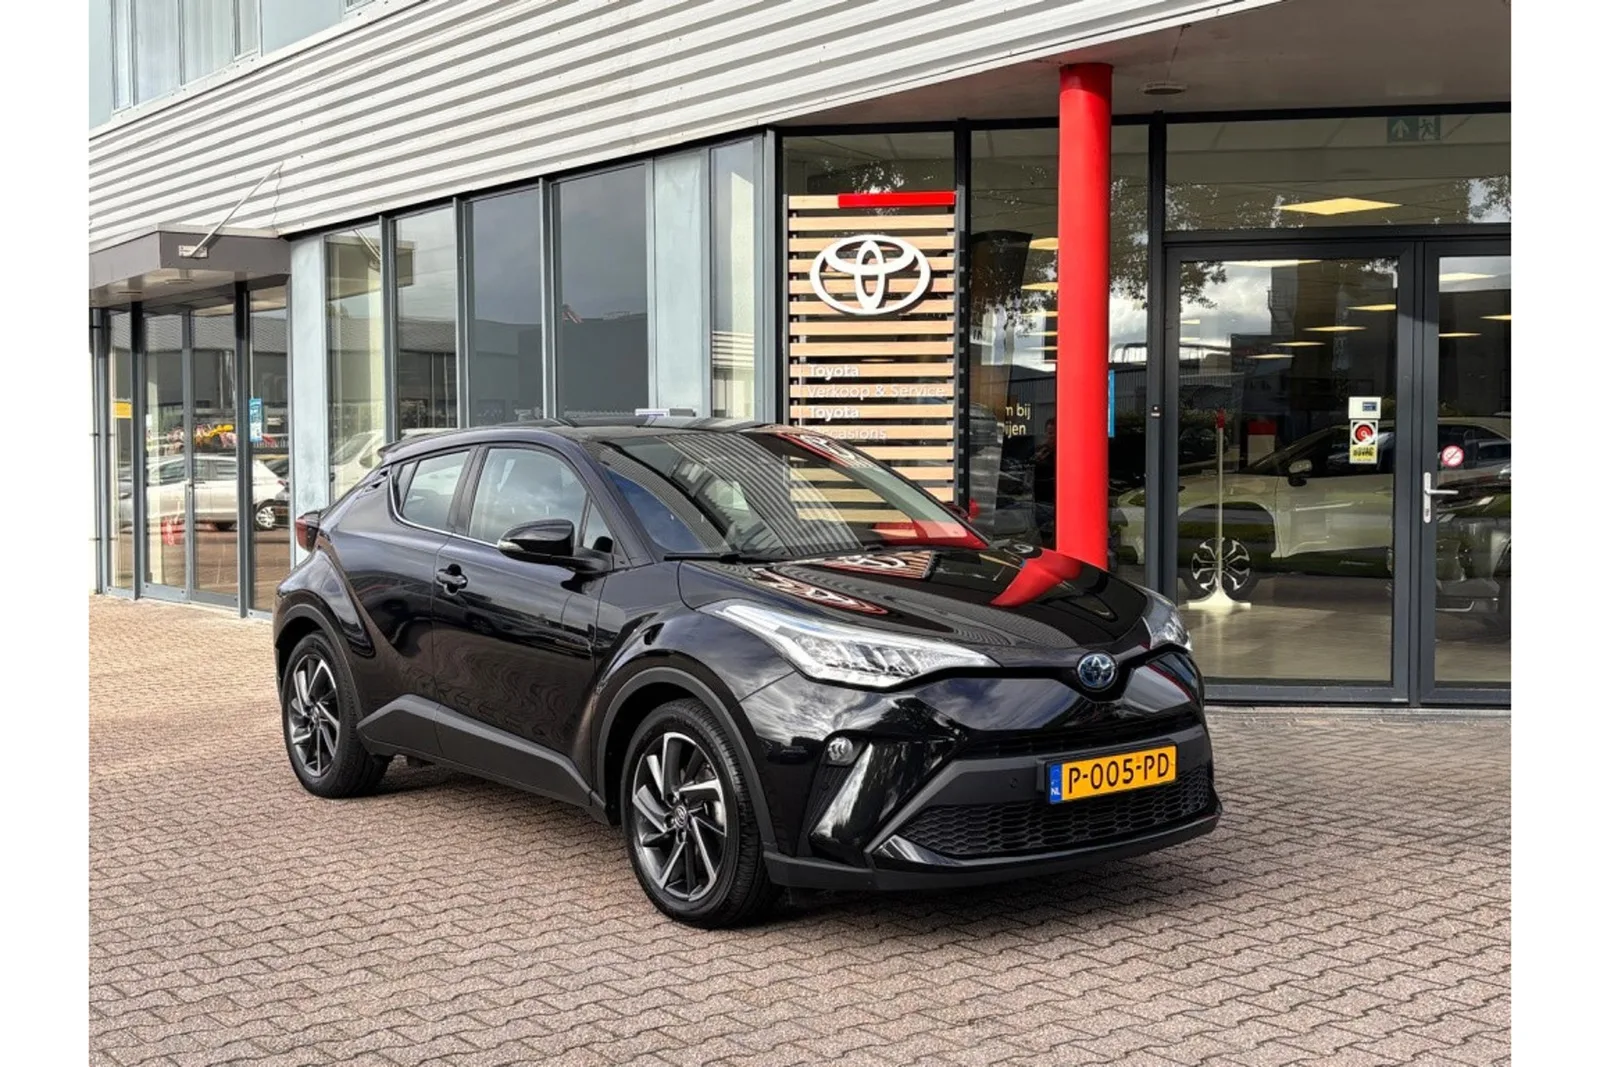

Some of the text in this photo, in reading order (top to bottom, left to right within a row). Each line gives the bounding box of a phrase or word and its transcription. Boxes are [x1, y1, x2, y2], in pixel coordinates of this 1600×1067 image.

[809, 364, 860, 381] Toyota
[807, 384, 945, 400] Verkoop & Service
[809, 406, 860, 421] Toyota
[1016, 402, 1031, 420] bij
[1068, 753, 1169, 794] P-005-PD
[1051, 787, 1061, 796] NL
